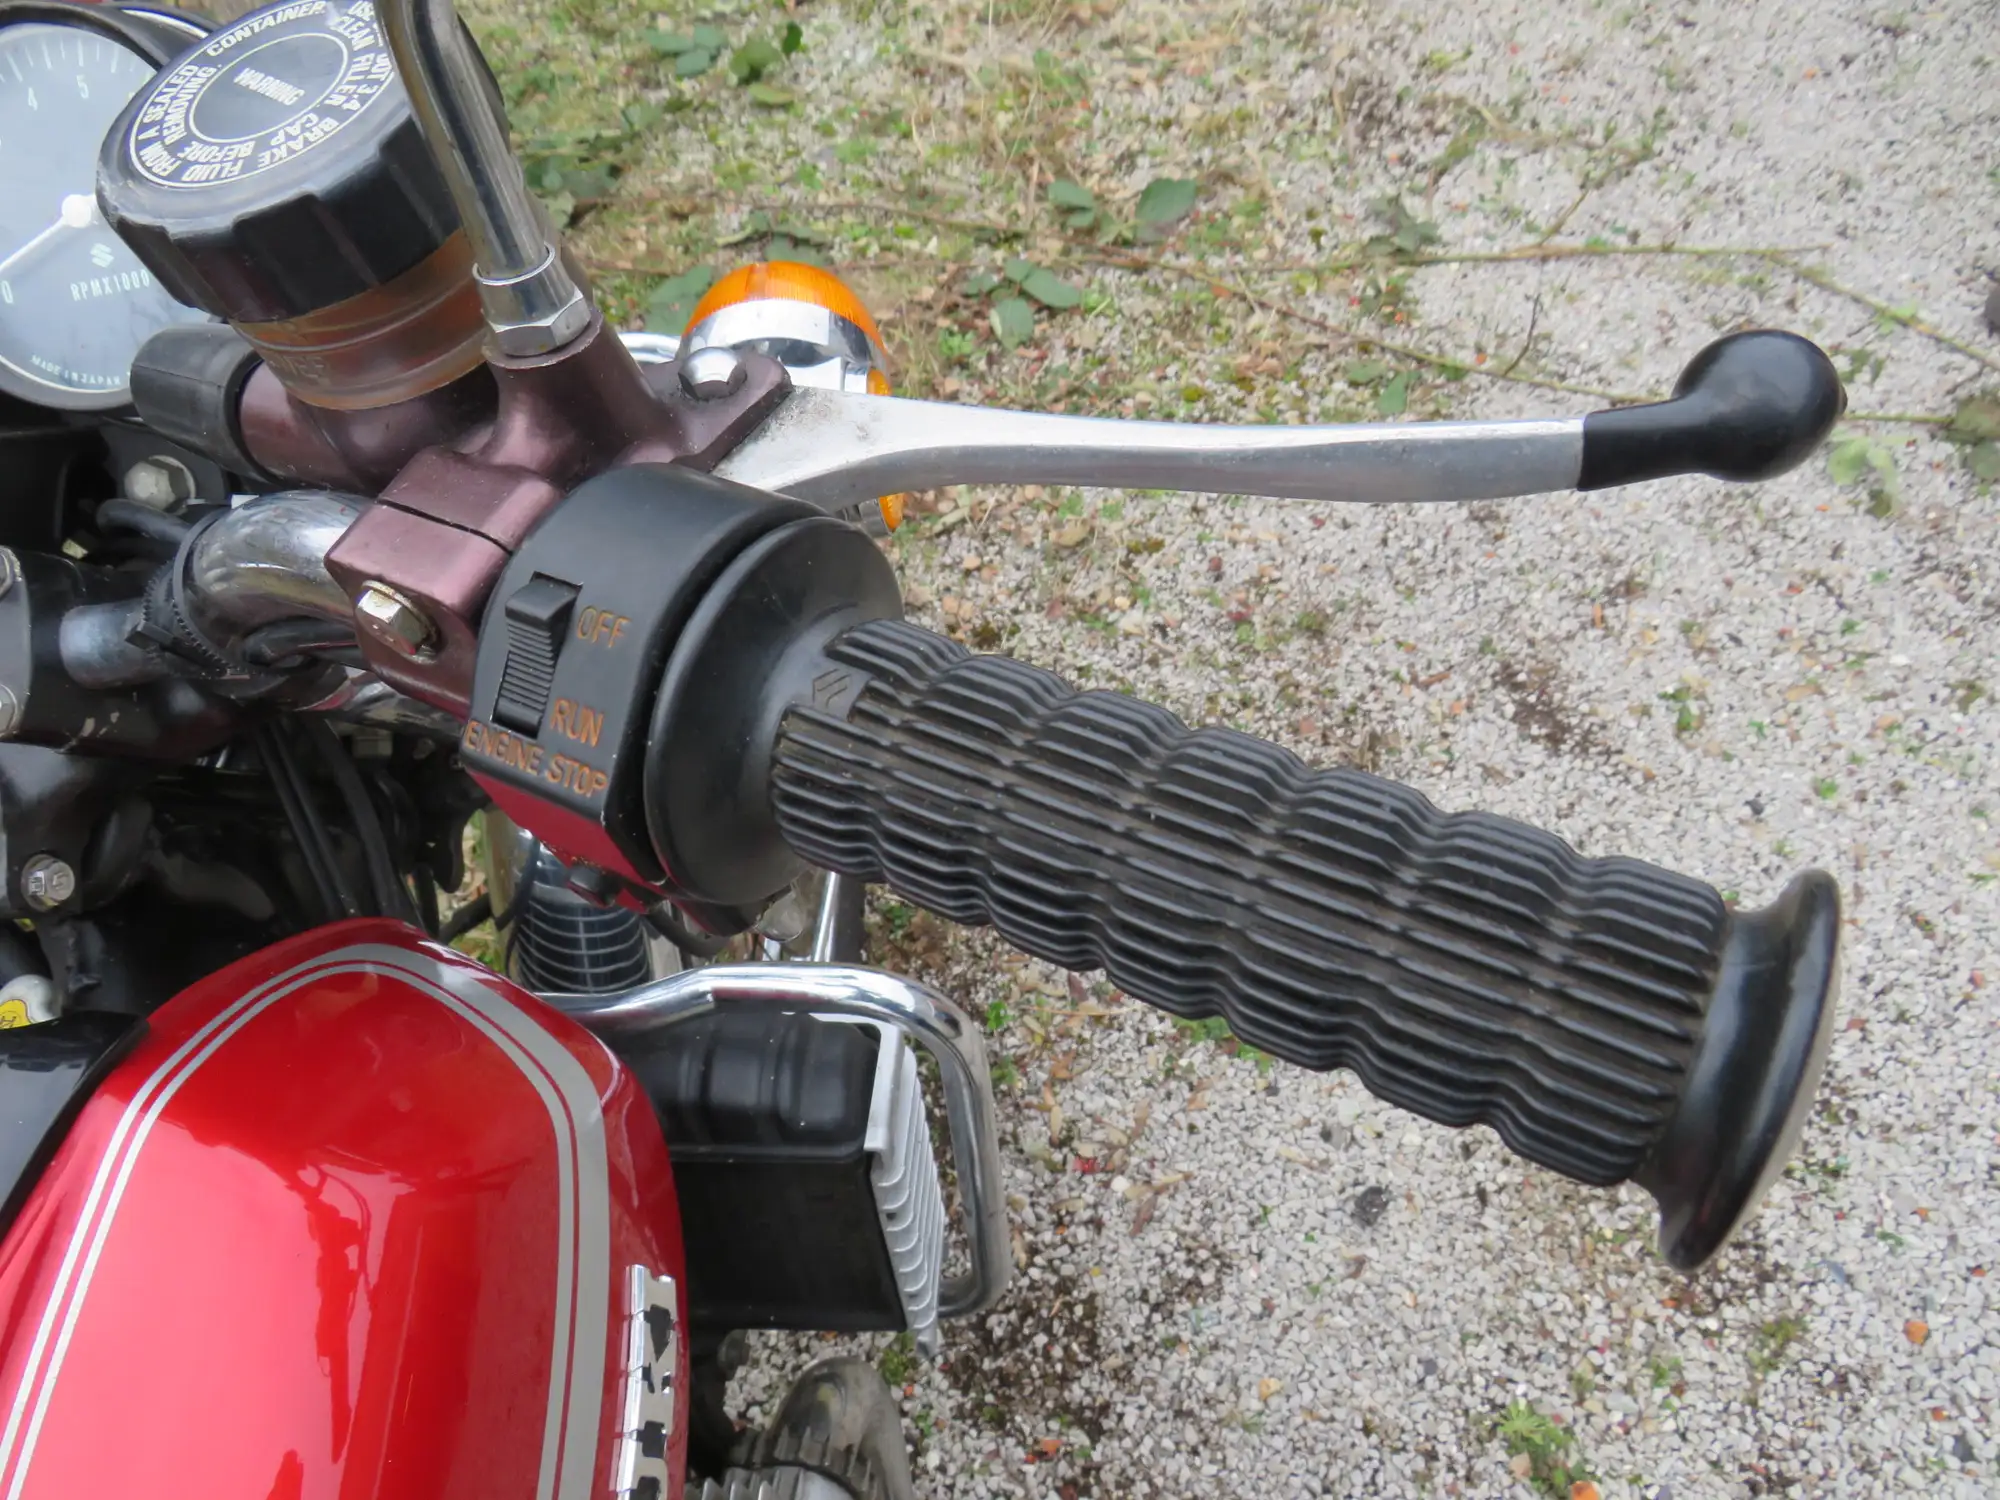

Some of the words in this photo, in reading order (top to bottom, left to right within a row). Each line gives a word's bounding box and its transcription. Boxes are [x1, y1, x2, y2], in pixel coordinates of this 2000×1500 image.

[206, 0, 326, 57] CONTAINER
[76, 74, 89, 99] 5
[142, 65, 200, 123] SEALED
[233, 67, 305, 106] WARNING
[323, 53, 376, 106] FILLER
[27, 86, 38, 111] 4
[138, 125, 160, 140] A
[257, 116, 340, 168] BRAKE
[270, 112, 320, 146] CAP
[139, 140, 182, 177] FROM
[177, 140, 256, 163] BEFORE
[181, 159, 244, 181] FLUID
[1, 279, 14, 304] 0
[31, 354, 61, 376] MADE
[80, 373, 121, 386] JAPAN
[577, 605, 632, 648] OFF
[551, 697, 604, 747] RUN
[464, 720, 545, 776] ENGINE
[545, 752, 608, 798] STOP
